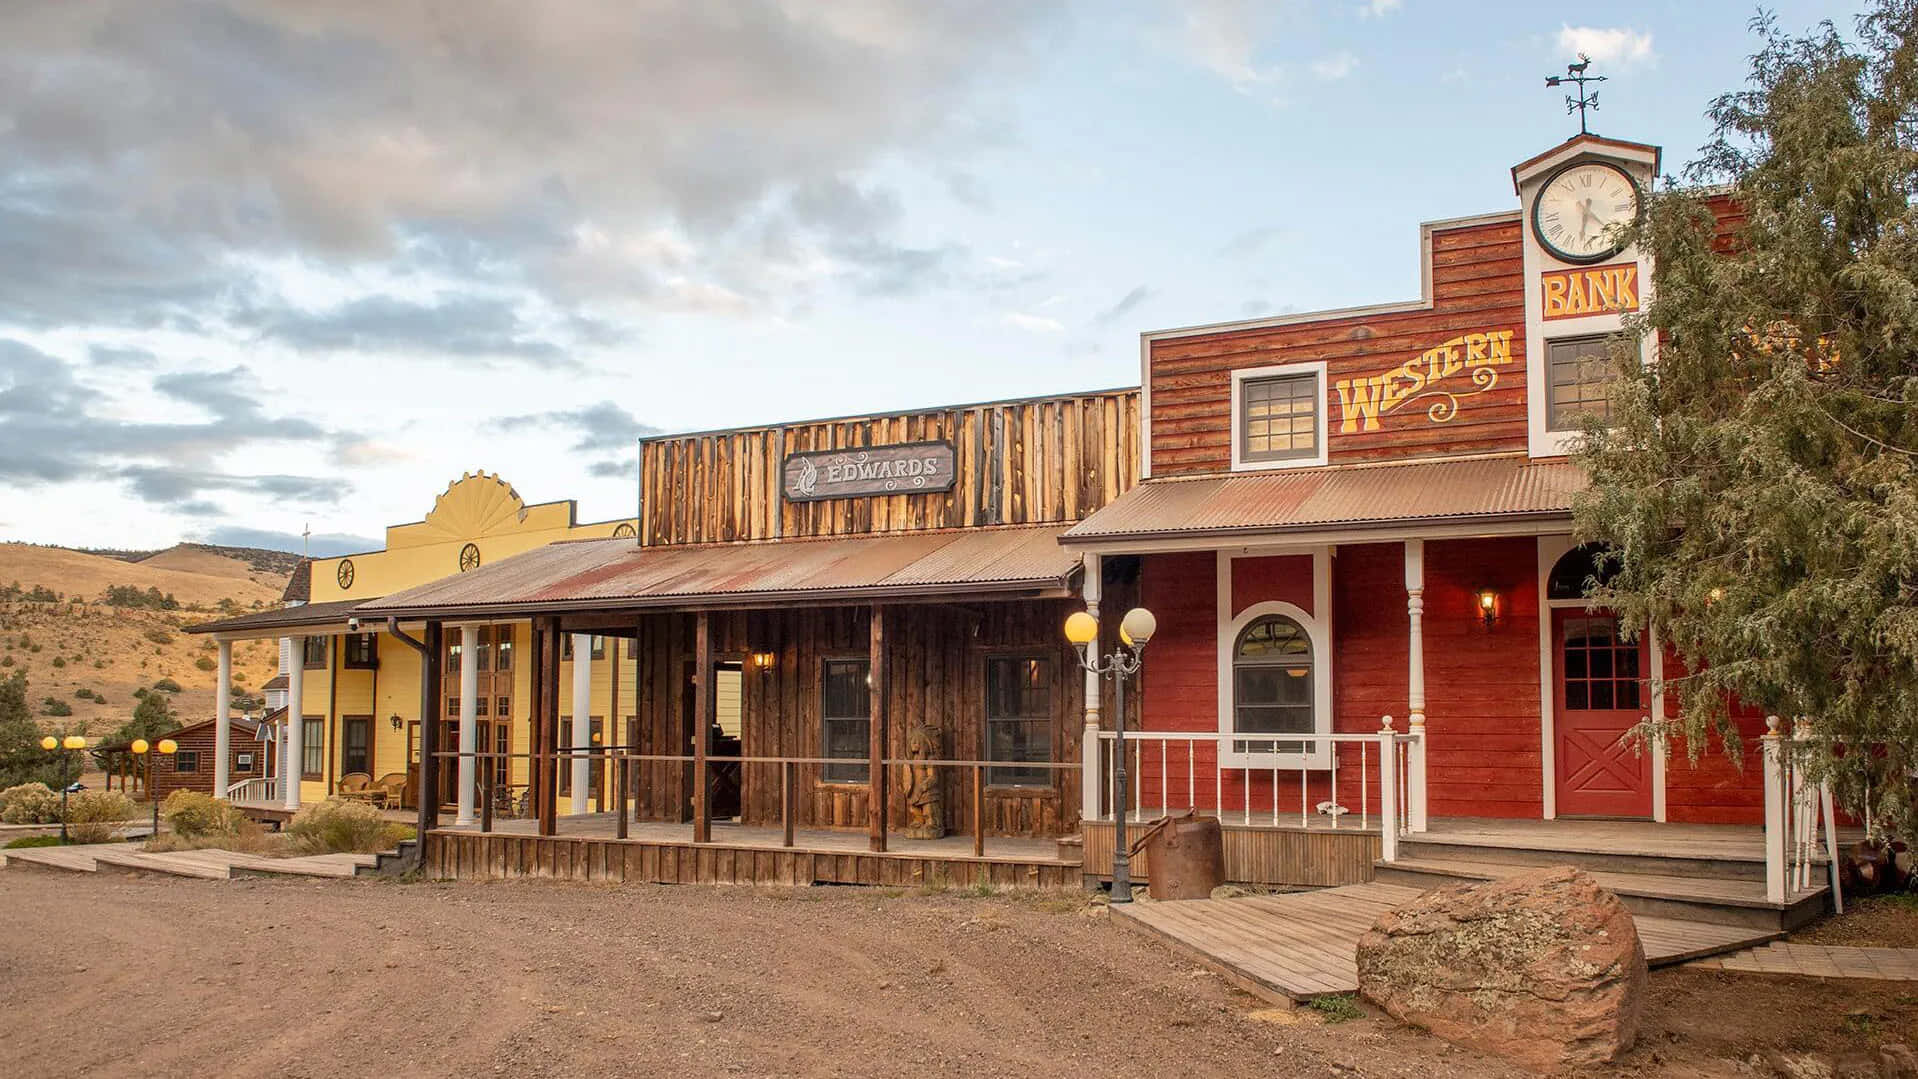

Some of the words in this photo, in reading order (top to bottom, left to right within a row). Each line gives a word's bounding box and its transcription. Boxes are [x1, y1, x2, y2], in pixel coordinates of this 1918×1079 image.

[1543, 267, 1638, 317] BANK
[1336, 330, 1514, 433] WESTERN
[827, 457, 938, 483] EDWARDS
